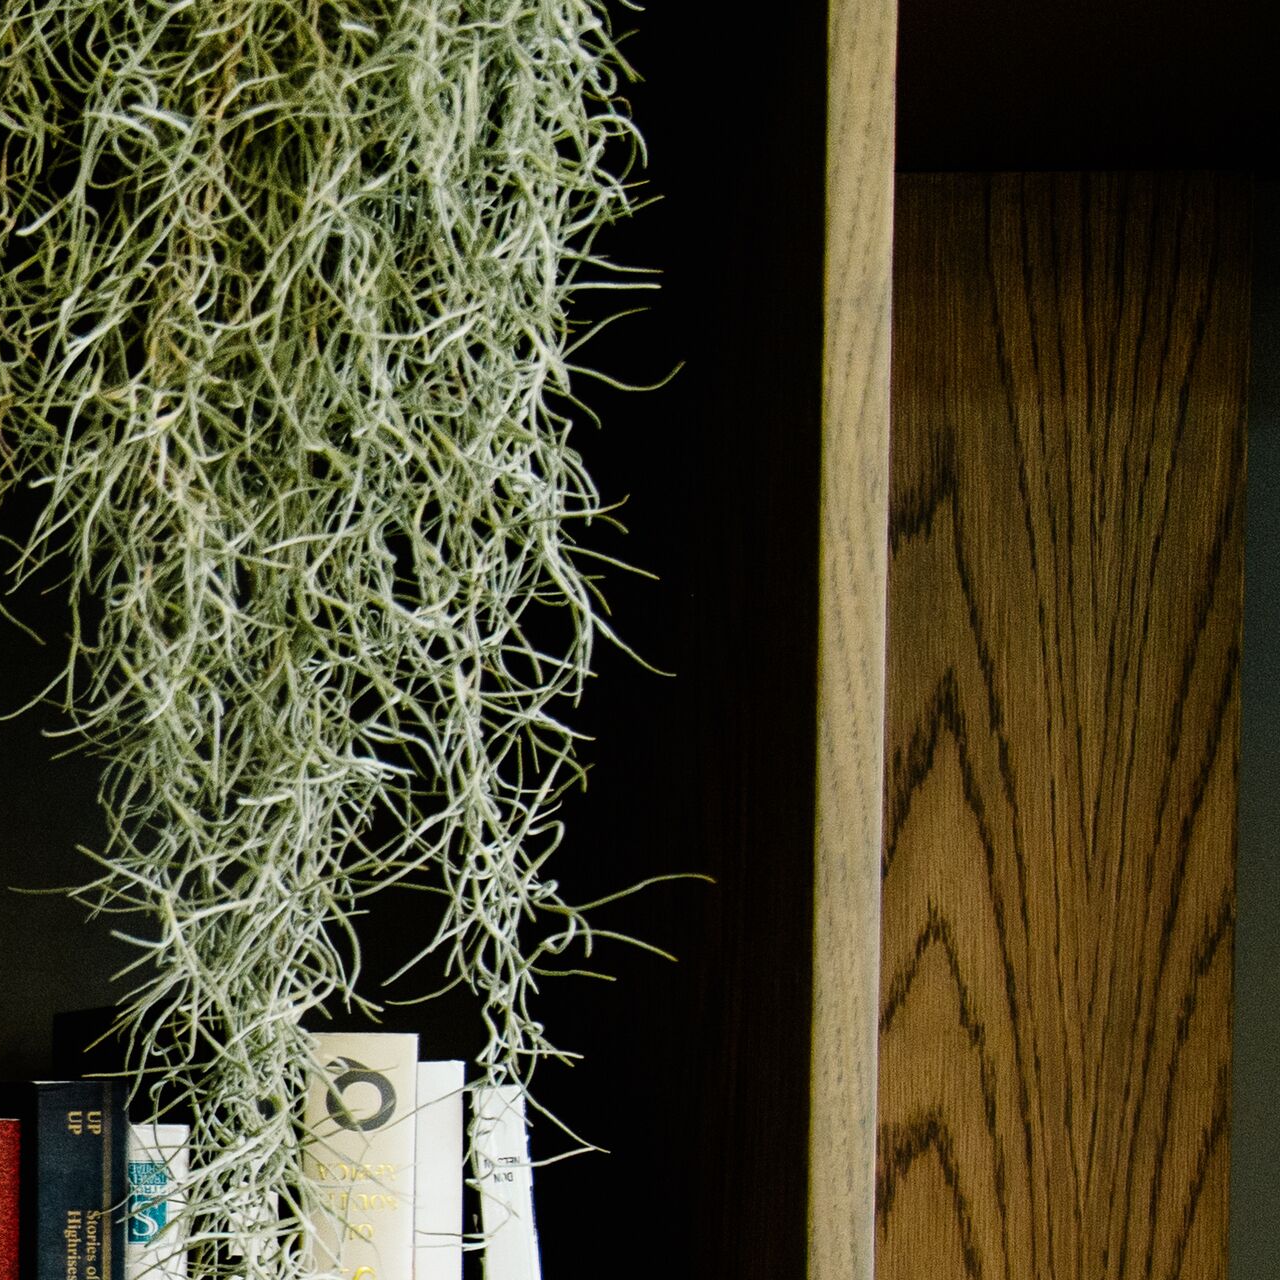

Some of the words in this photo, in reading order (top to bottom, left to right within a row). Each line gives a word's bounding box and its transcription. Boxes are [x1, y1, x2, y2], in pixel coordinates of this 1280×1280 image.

[67, 1110, 82, 1135] UP
[87, 1110, 102, 1135] UP
[85, 1210, 100, 1262] Stories
[85, 1265, 100, 1280] of
